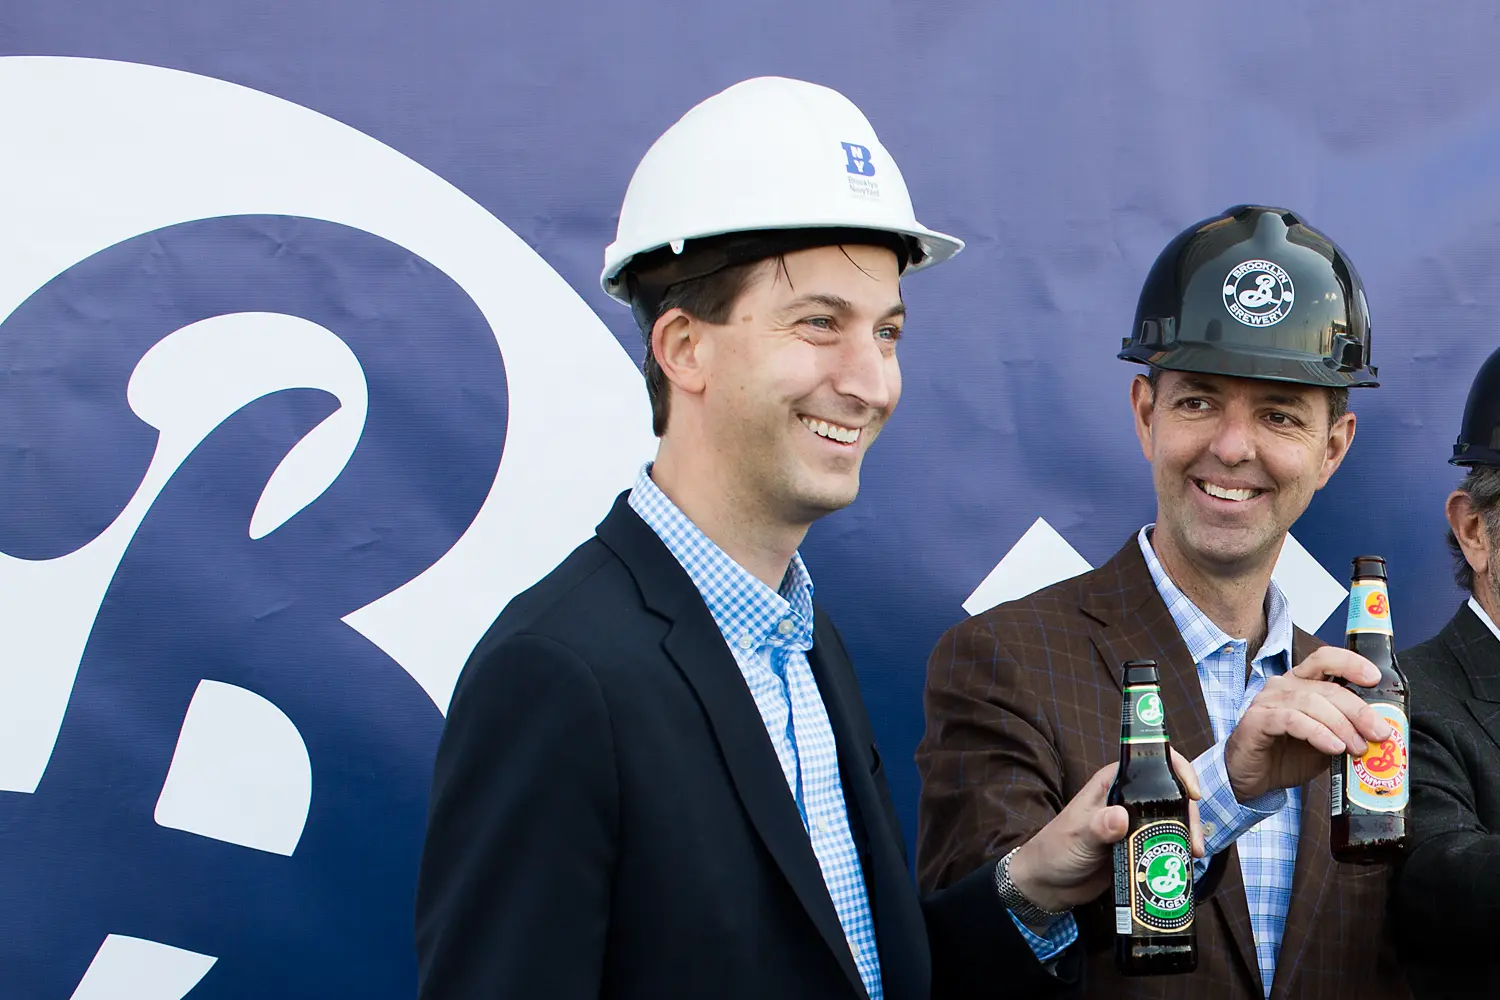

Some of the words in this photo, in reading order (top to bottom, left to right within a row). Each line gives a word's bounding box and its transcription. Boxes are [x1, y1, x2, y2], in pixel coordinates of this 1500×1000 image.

[1232, 262, 1288, 284] BROOKLYN
[1230, 303, 1284, 325] BREWERY
[1140, 844, 1191, 867] BROOKLYN
[1150, 894, 1187, 909] LAGER
